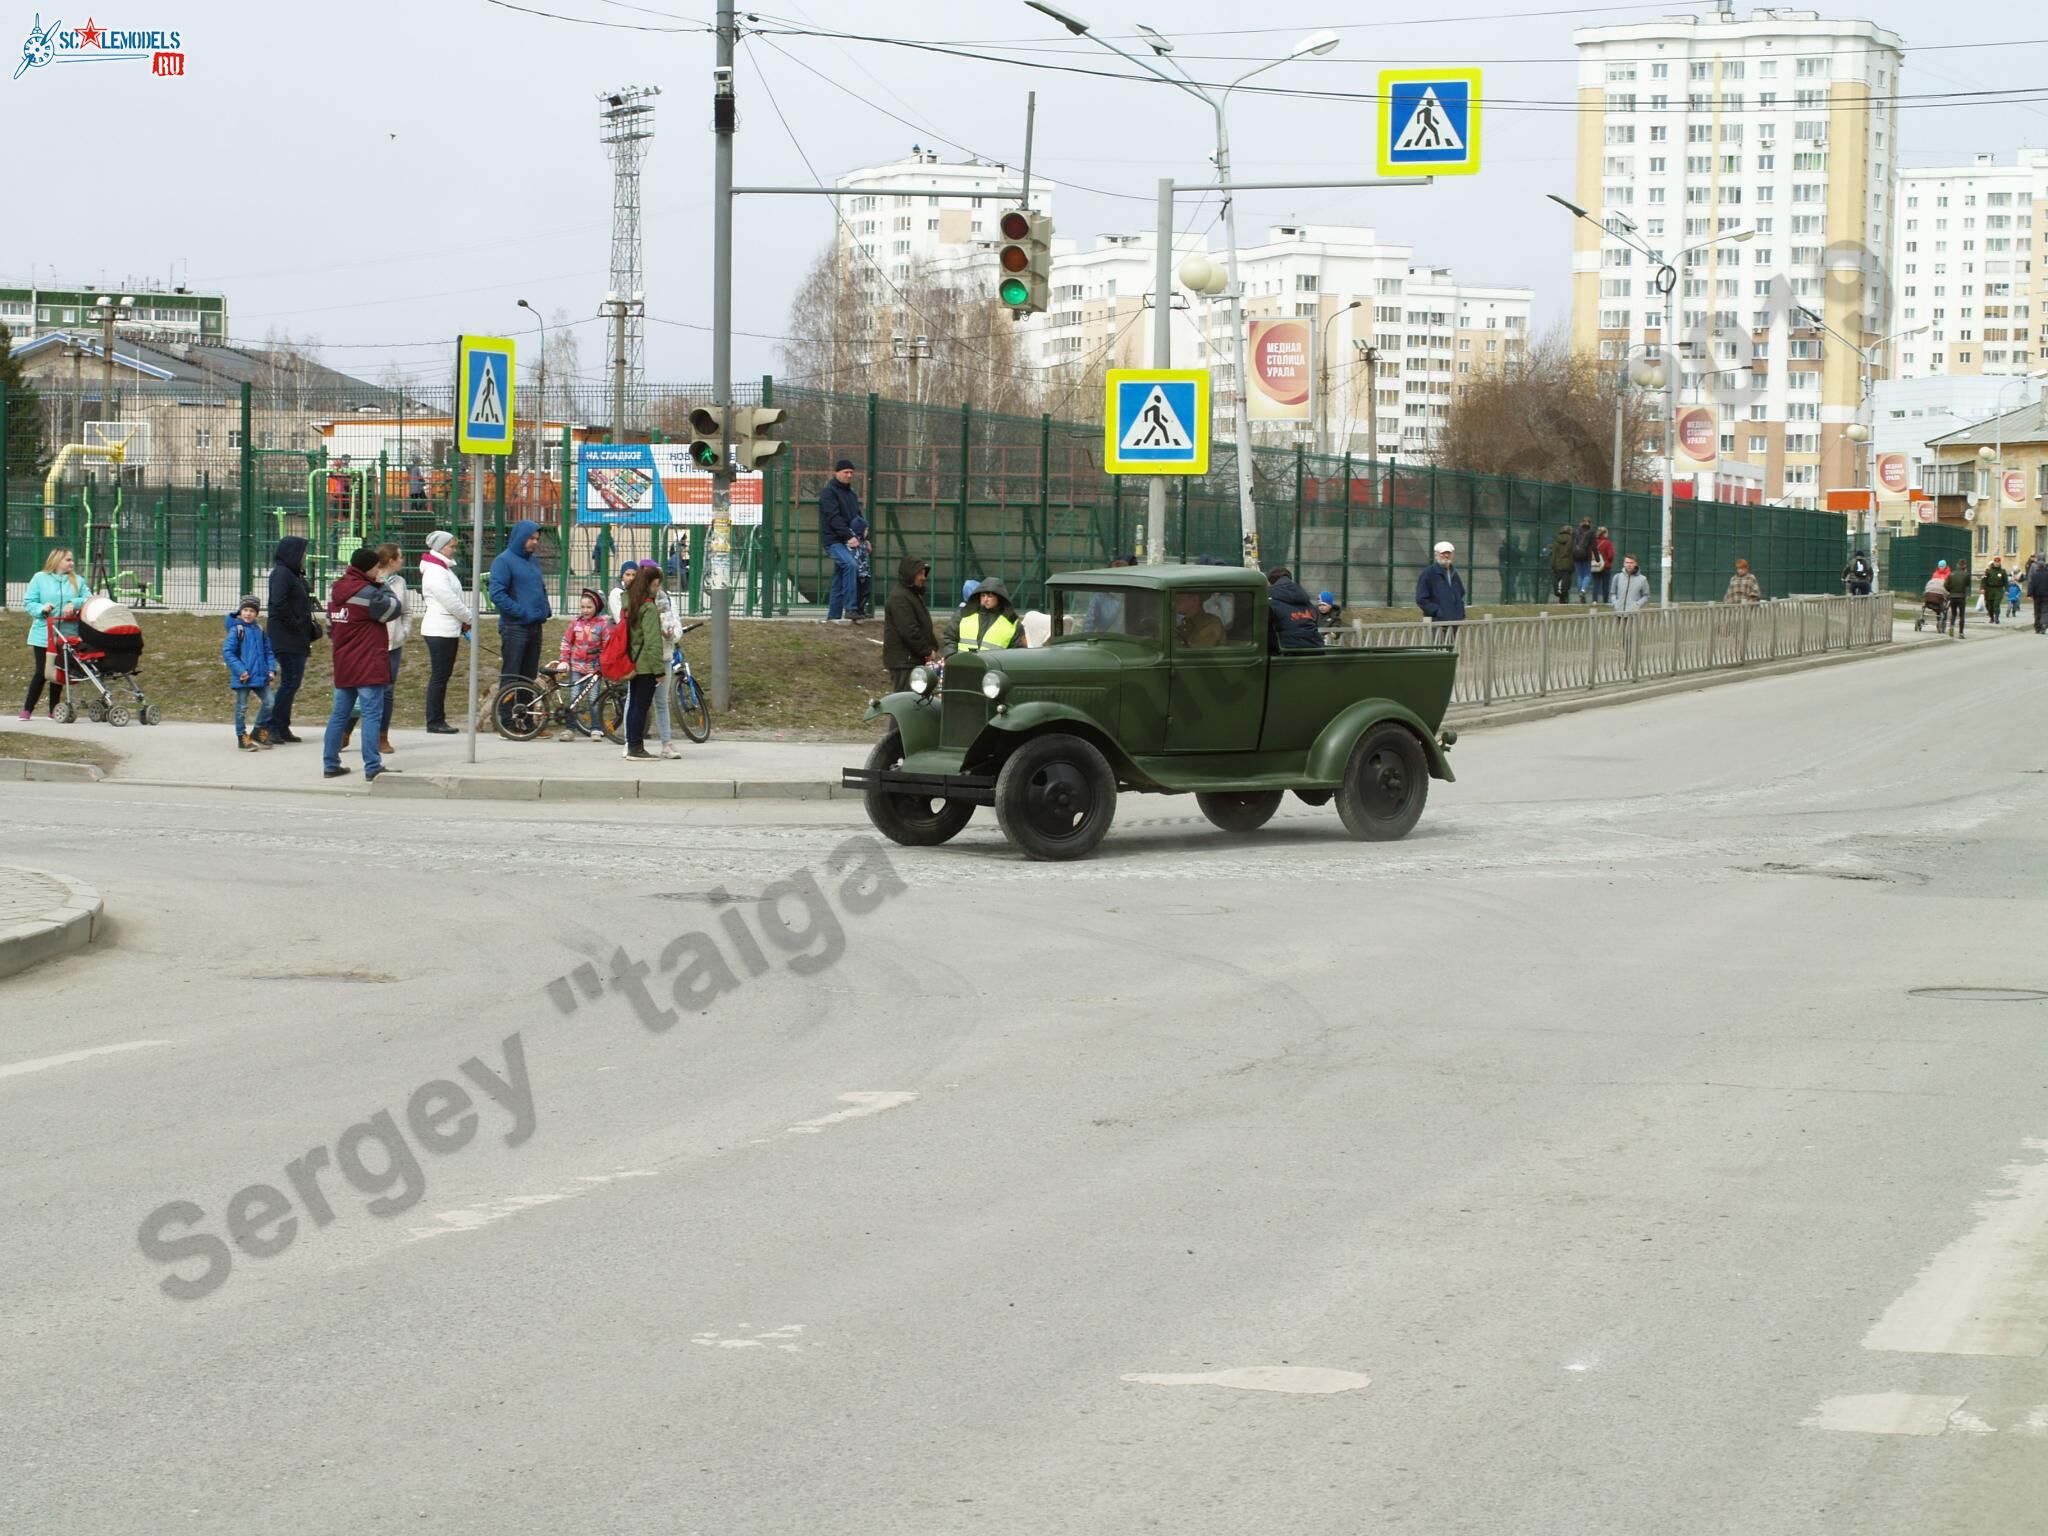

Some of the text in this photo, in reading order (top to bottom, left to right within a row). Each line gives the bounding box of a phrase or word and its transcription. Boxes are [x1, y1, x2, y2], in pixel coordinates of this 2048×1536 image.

[1267, 342, 1301, 353] МЕДНАЯ
[1266, 354, 1305, 367] СТОЛИЦА
[1267, 367, 1295, 377] УРАЛА
